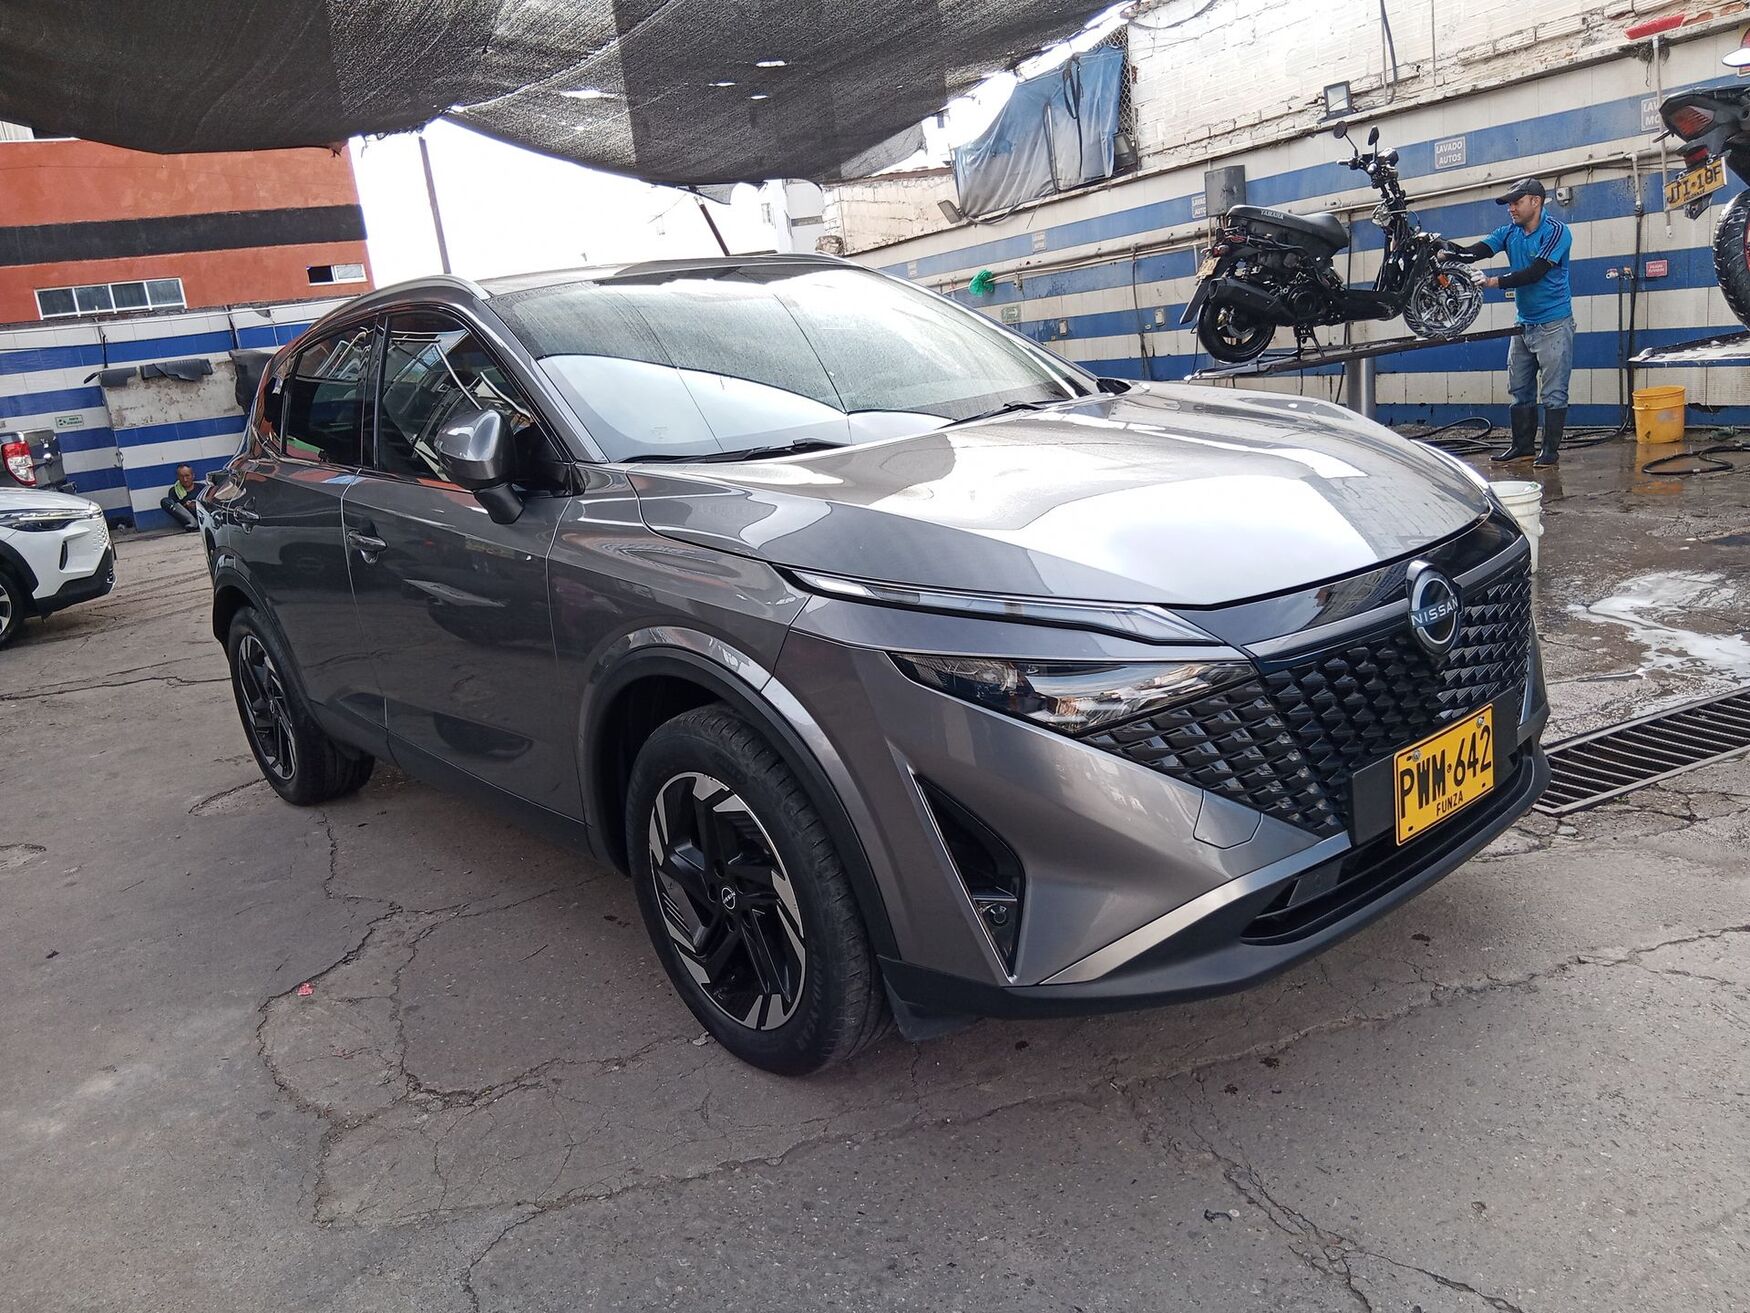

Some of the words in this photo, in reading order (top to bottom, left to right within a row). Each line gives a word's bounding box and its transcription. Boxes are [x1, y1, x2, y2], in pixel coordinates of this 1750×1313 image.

[1436, 140, 1463, 154] LAVADO
[1439, 153, 1462, 165] AUTOS
[1260, 208, 1284, 220] YAMAHA
[1411, 596, 1459, 626] NISSAN
[1436, 790, 1463, 816] FUNZA
